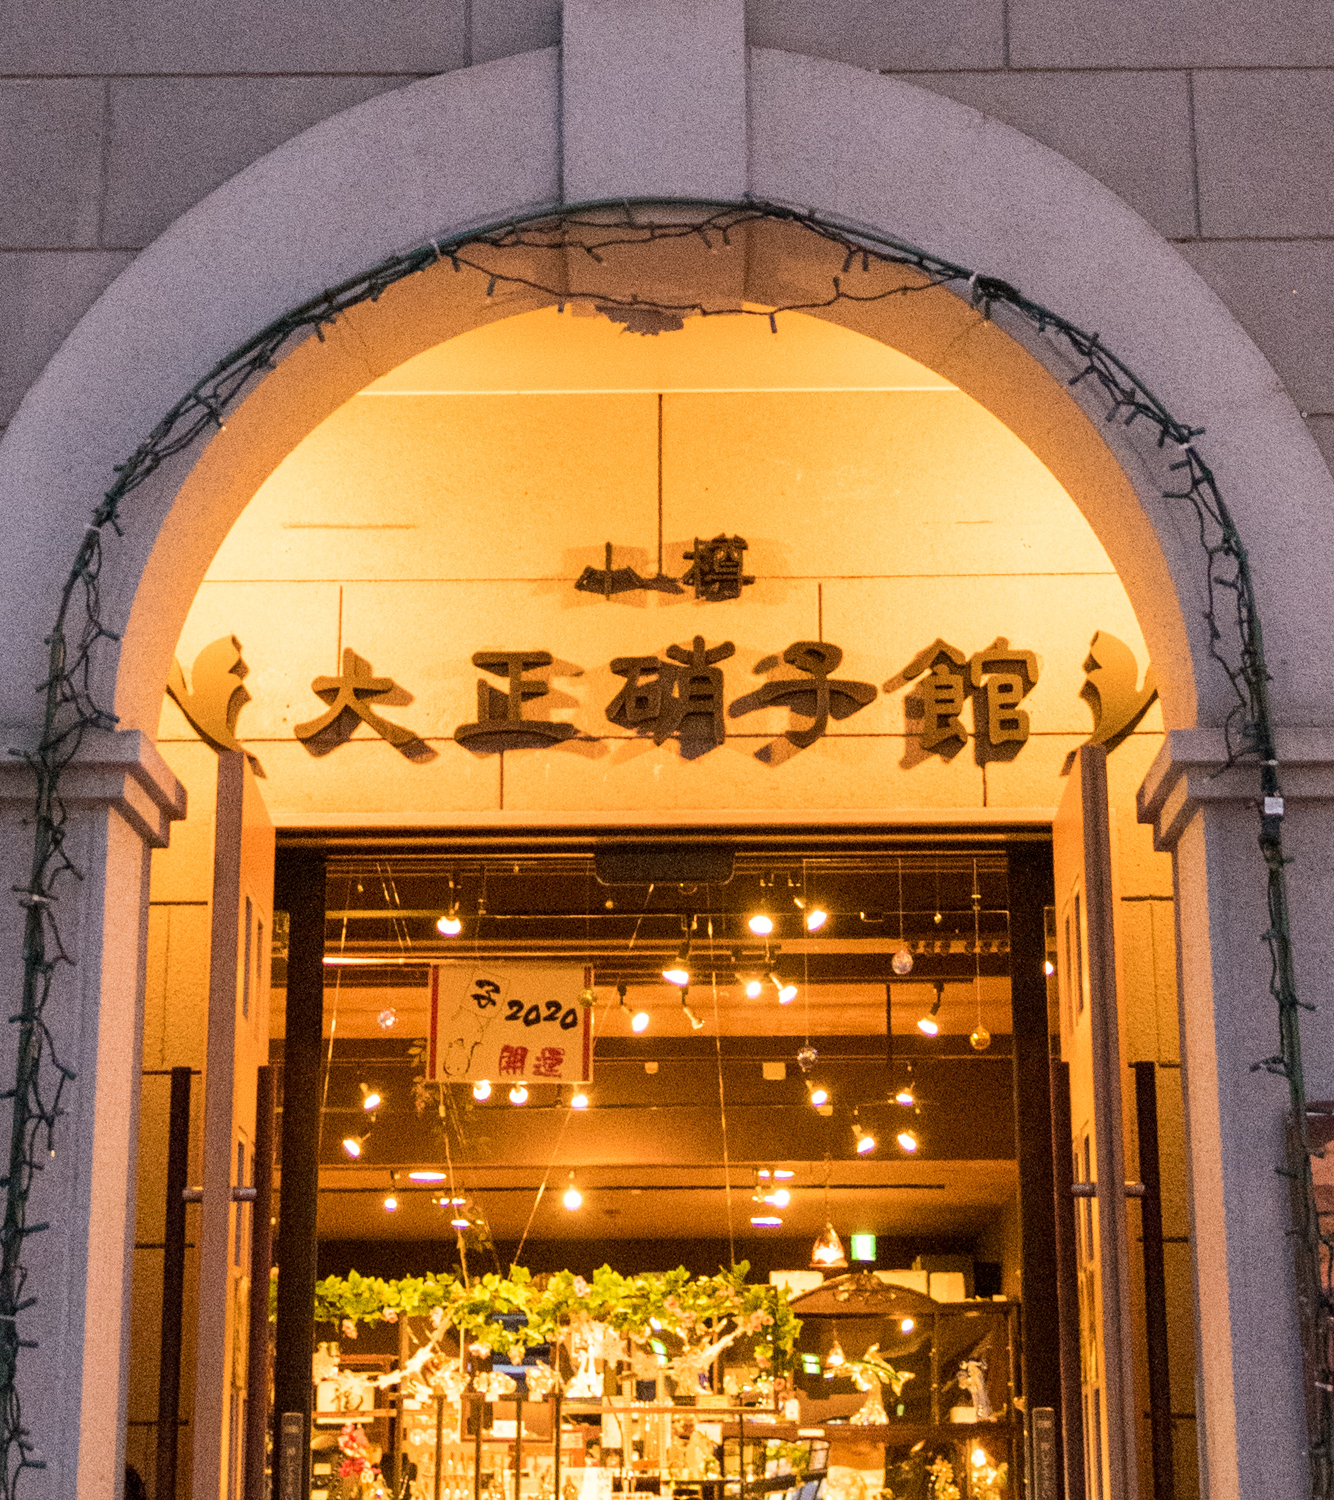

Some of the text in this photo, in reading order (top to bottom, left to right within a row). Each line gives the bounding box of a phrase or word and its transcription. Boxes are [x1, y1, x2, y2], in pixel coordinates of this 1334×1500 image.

[575, 530, 756, 602] 小樽
[293, 634, 1039, 755] 大正硝子館
[504, 999, 579, 1031] 2020
